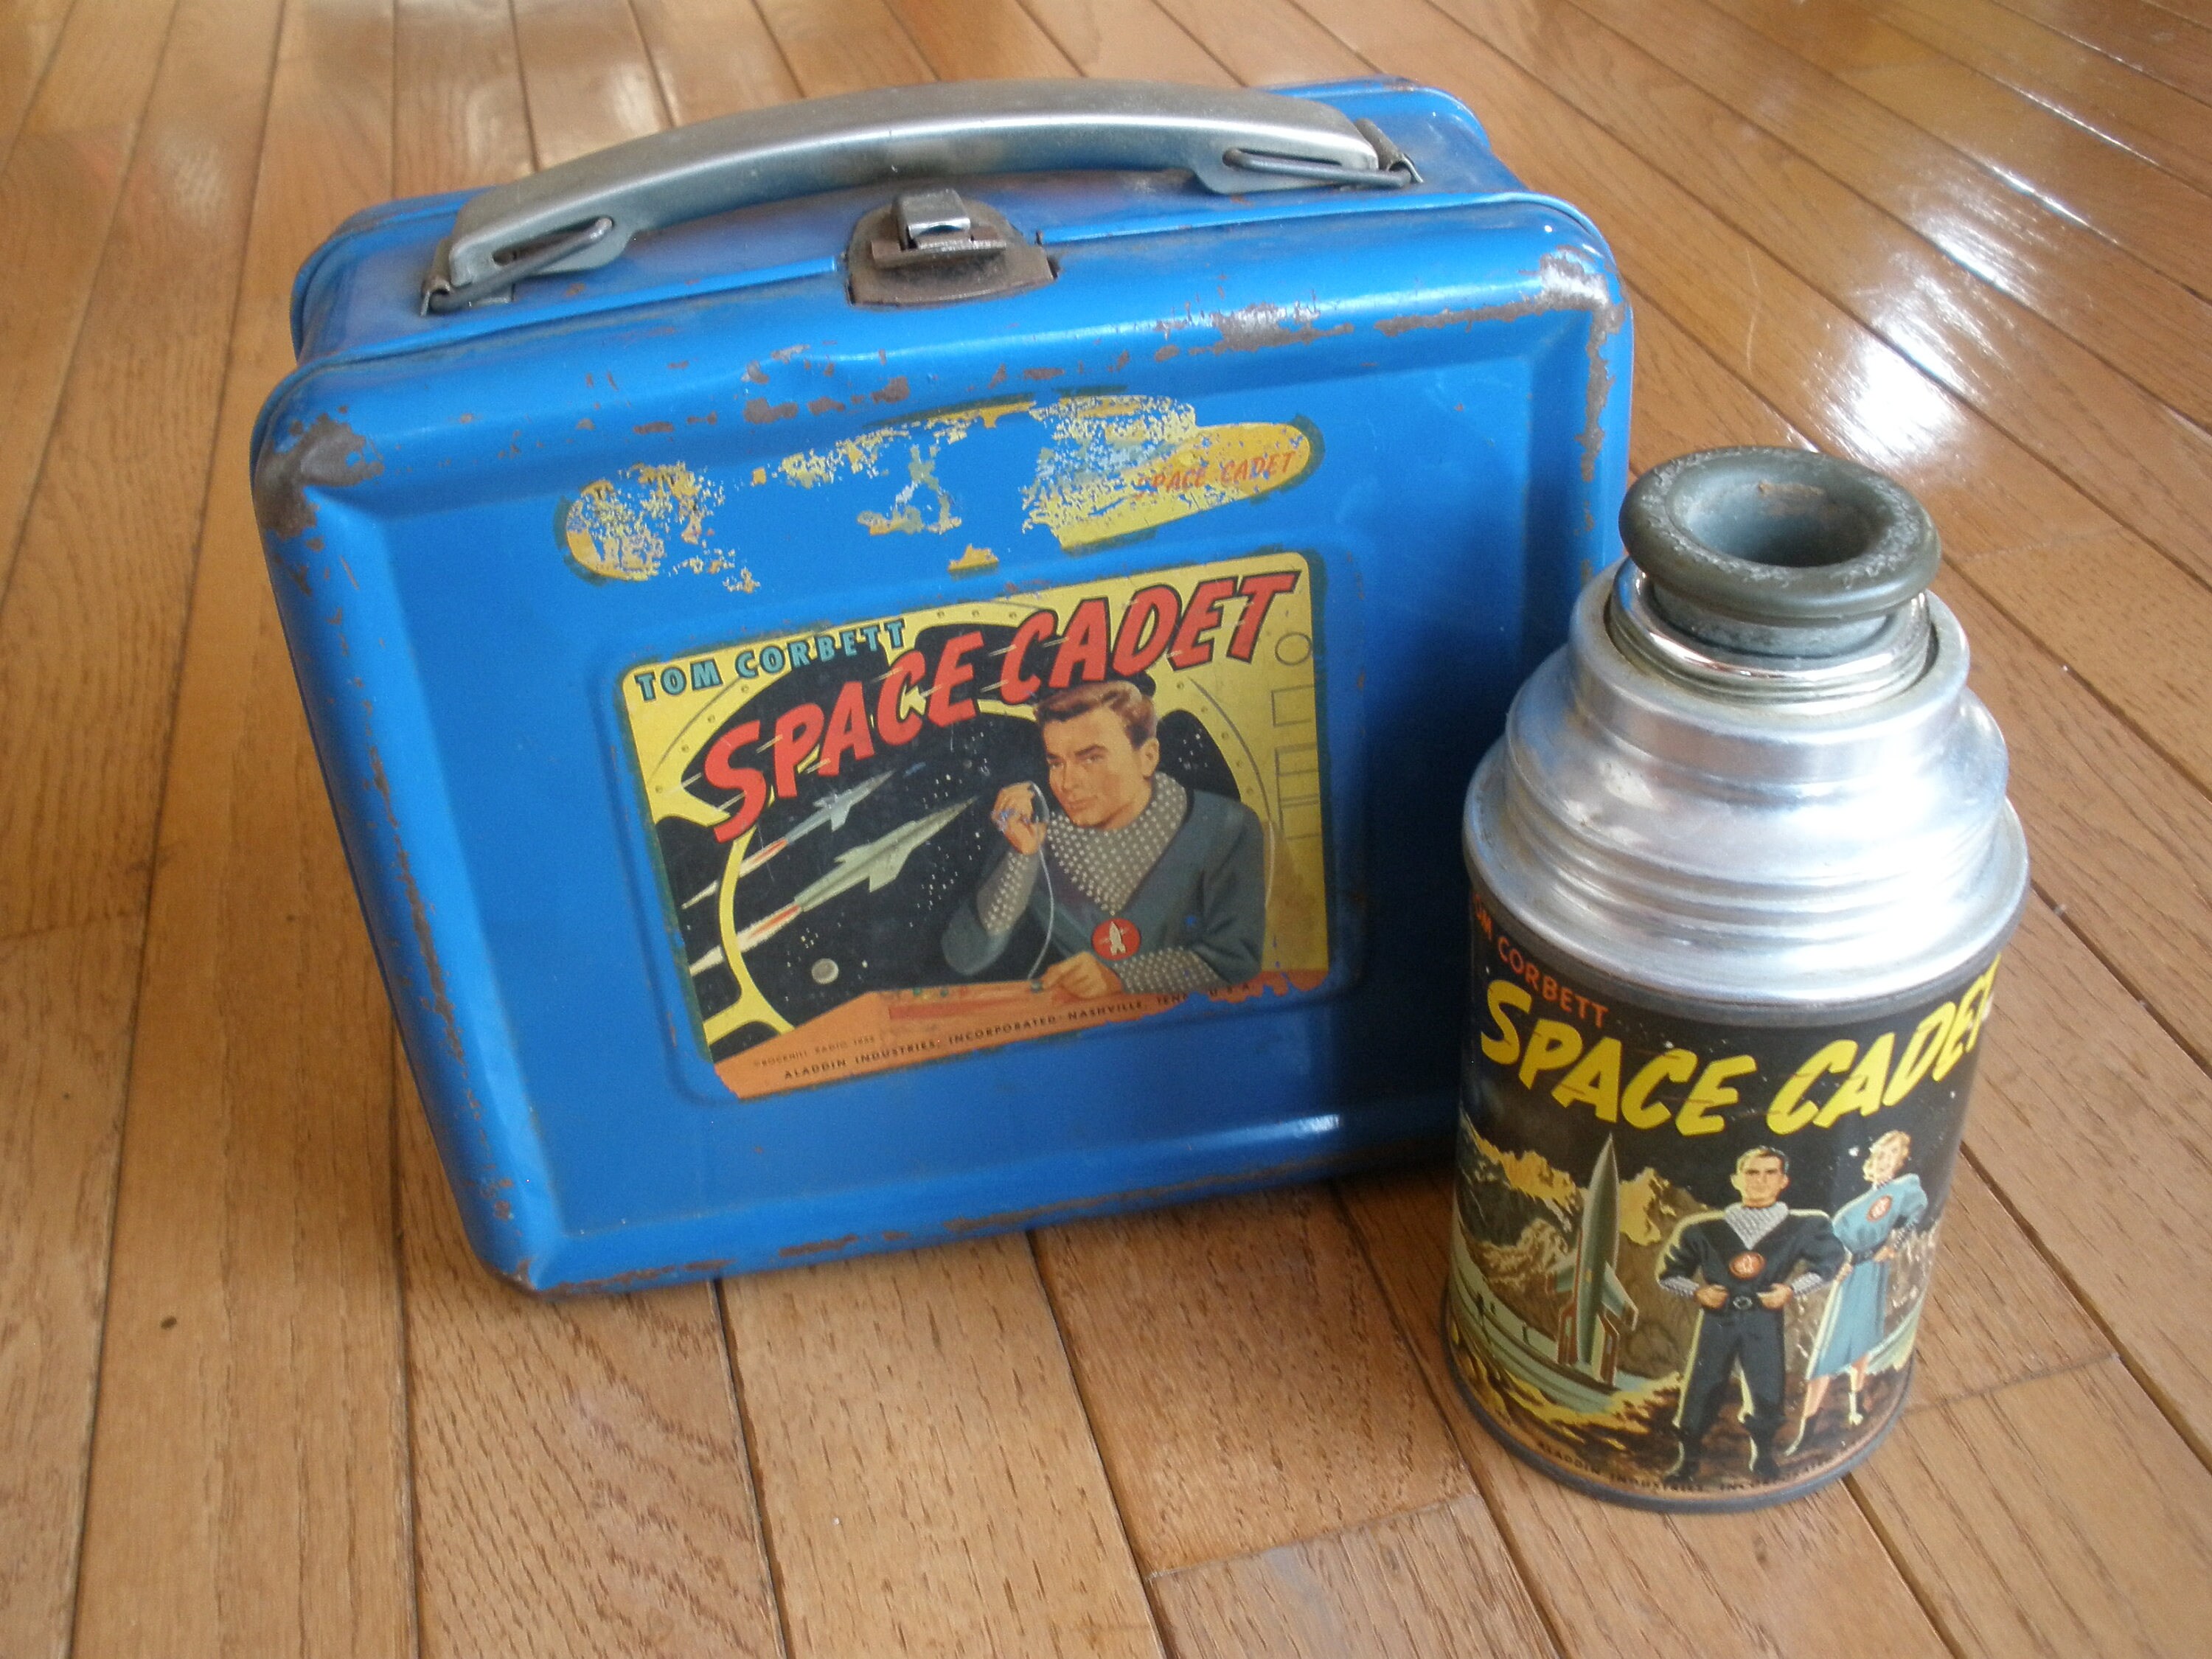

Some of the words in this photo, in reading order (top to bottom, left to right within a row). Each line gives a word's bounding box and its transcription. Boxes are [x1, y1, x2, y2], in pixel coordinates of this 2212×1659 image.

[636, 657, 722, 703] TOM
[736, 619, 908, 681] CORBETT
[702, 630, 987, 842] SPACE
[998, 570, 1303, 706] CADET
[1497, 936, 1609, 1029] CORBETT
[784, 1060, 847, 1080] ALADDIN
[949, 1015, 1057, 1045] INCORPORATED
[1480, 978, 1758, 1136] SPACE
